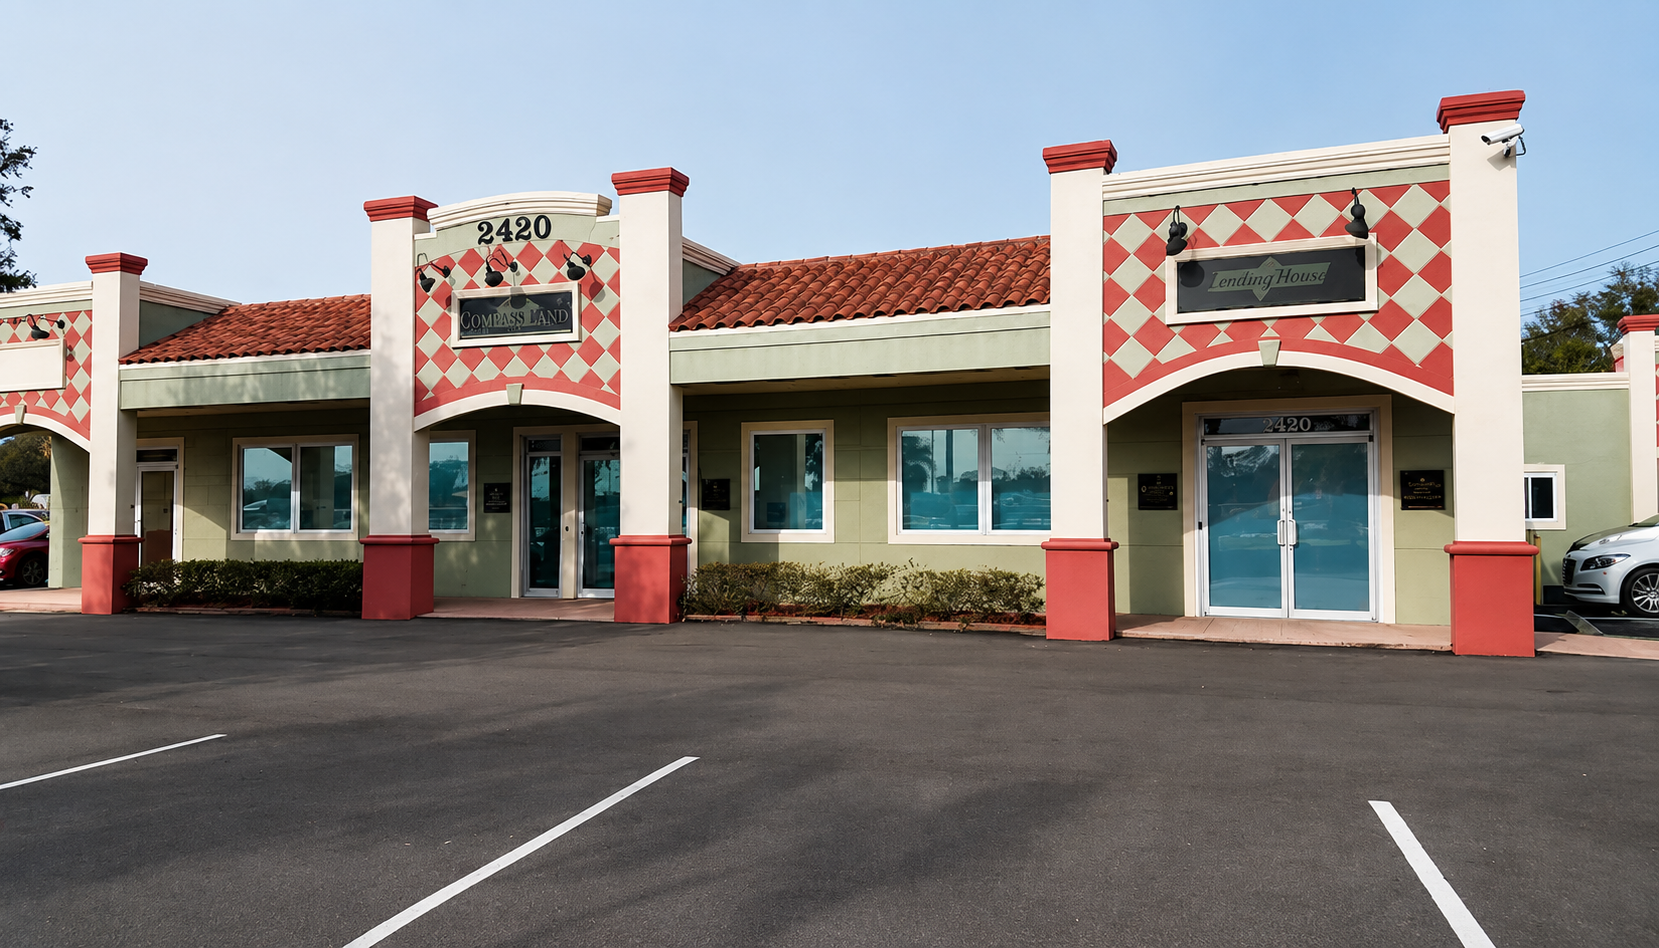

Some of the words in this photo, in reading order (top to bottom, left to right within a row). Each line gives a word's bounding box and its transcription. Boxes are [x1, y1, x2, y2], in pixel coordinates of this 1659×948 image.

[477, 214, 552, 245] 2420
[1209, 269, 1275, 292] Lending
[1274, 267, 1326, 284] House
[460, 310, 525, 329] COMPASS
[529, 308, 570, 326] LAND
[1262, 416, 1312, 433] 2420
